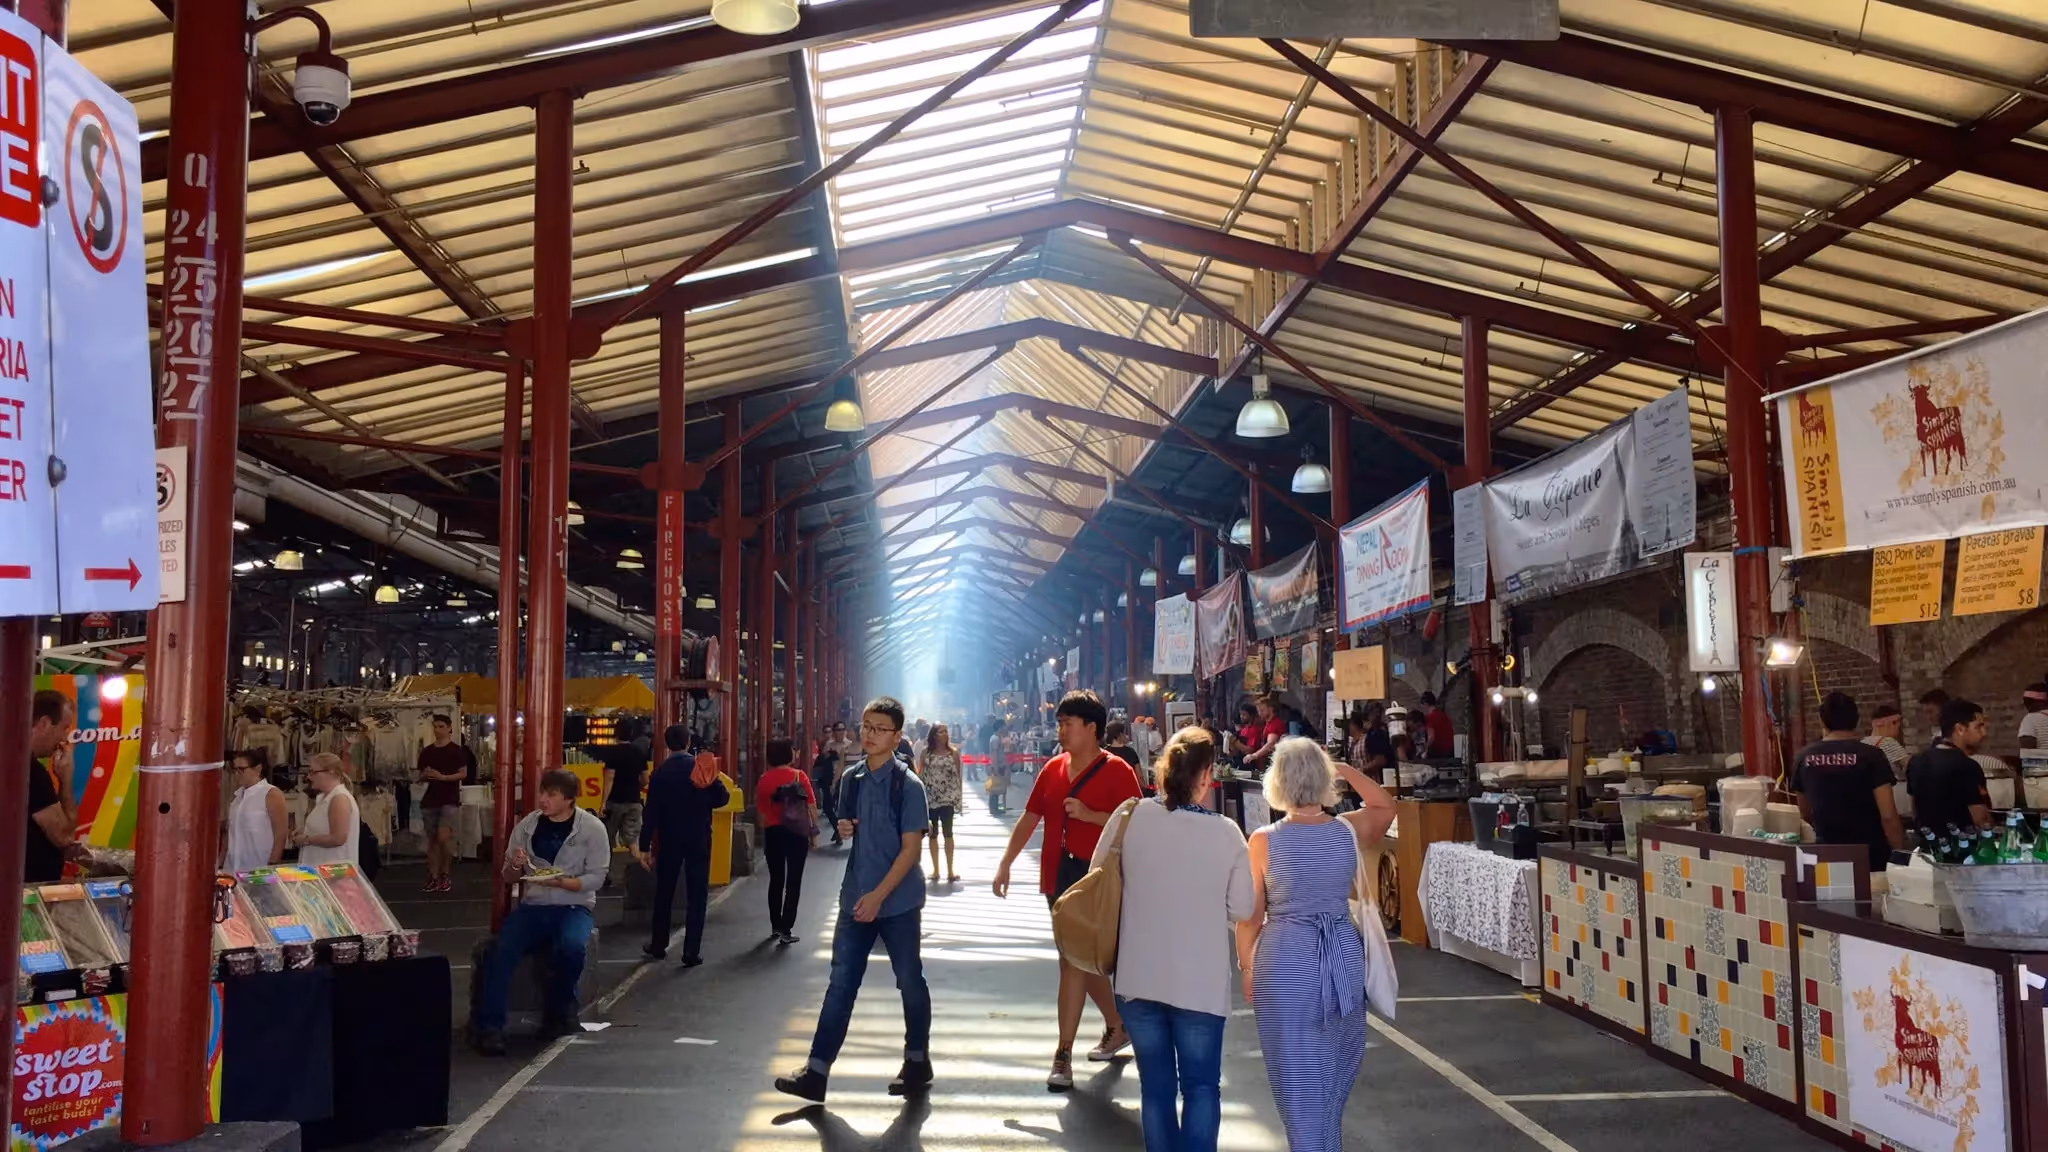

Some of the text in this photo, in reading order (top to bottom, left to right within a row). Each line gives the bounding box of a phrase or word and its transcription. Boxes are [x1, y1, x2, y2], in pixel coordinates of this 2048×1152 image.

[170, 209, 219, 245] 24
[170, 266, 217, 303] 25
[166, 319, 213, 356] 26
[162, 370, 211, 409] 27
[1922, 407, 1955, 432] Simply
[1926, 416, 1962, 448] SPANISH
[1507, 484, 1532, 521] La
[1817, 452, 1835, 538] Simply
[1886, 477, 2017, 510] www.simplyspanish.com.au
[1700, 557, 1720, 569] La
[1875, 550, 1893, 567] BBQ
[1920, 602, 1939, 618] $12
[2017, 588, 2034, 606] $8
[1901, 1027, 1933, 1047] Simply
[14, 1038, 114, 1076] sweet
[23, 1069, 102, 1101] stop
[30, 1106, 97, 1126] taste buds!
[76, 1096, 104, 1110] your
